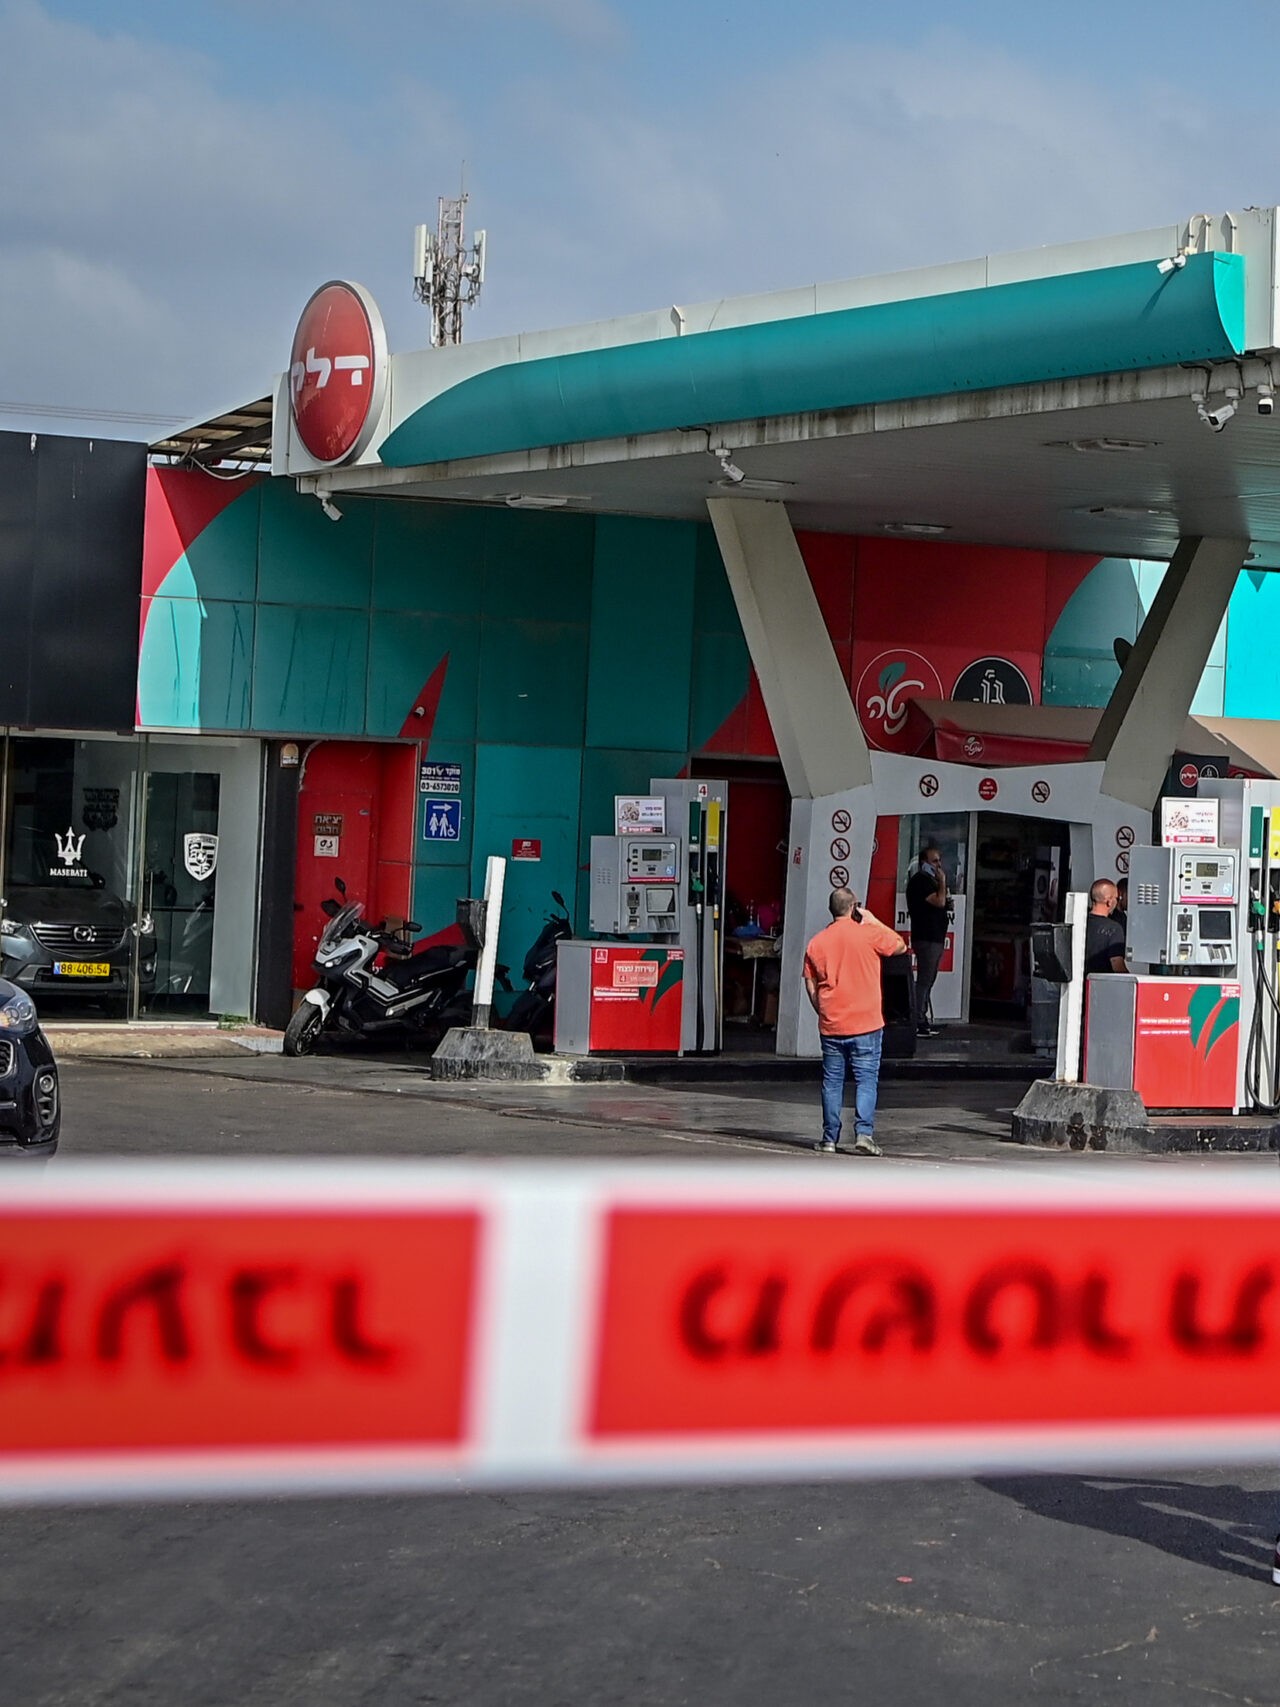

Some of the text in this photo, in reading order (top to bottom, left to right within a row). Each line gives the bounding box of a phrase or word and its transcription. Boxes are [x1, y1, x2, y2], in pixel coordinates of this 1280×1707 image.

[291, 347, 369, 400] דלק
[421, 767, 436, 775] 301
[699, 785, 706, 795] 4
[678, 1255, 1276, 1364] משטרת
